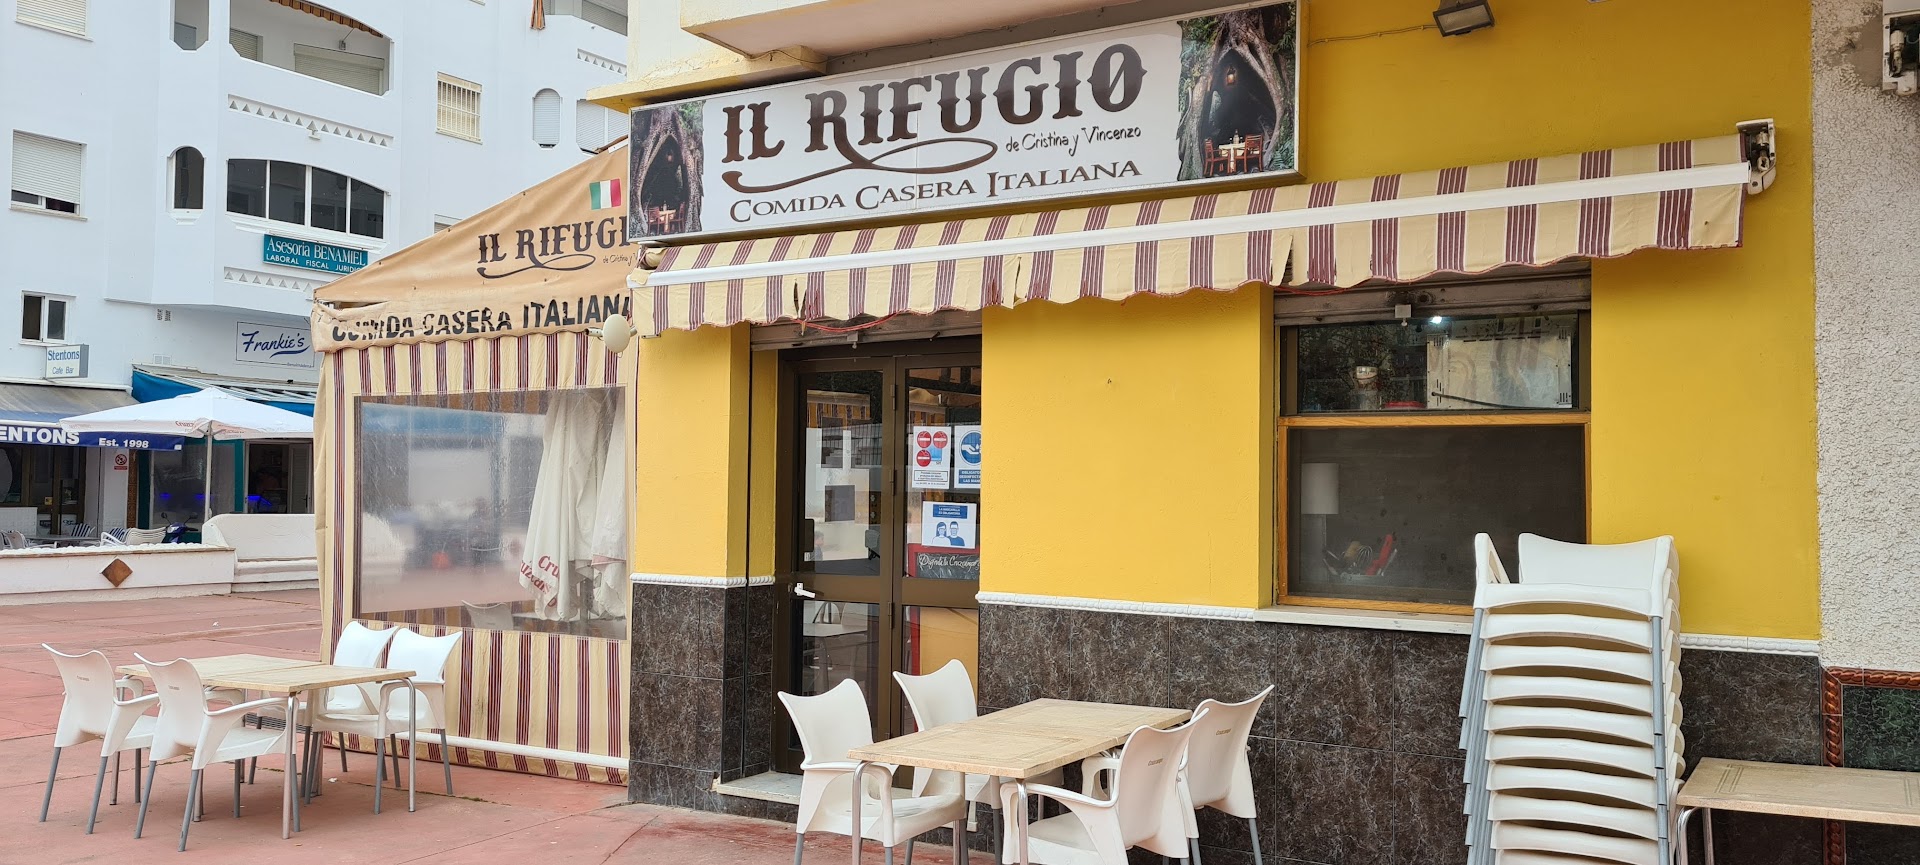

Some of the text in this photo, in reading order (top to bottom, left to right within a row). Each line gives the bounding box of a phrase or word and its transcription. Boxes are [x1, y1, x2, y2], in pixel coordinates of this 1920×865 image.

[721, 43, 1148, 164] IL RIFUGIO
[1005, 126, 1142, 157] de Cristina y Vincenzo
[729, 160, 1143, 223] COMIDA CASERA ITALIANA
[267, 237, 366, 266] Asesoria BENAMIEL
[477, 215, 630, 264] IL RIFUGI
[266, 254, 299, 265] LABORAL
[305, 260, 329, 270] FISCAL
[423, 306, 513, 335] CASERA
[48, 350, 80, 361] Stentons
[241, 330, 305, 353] Frankie's
[98, 437, 119, 447] Est.
[123, 439, 149, 448] 1998
